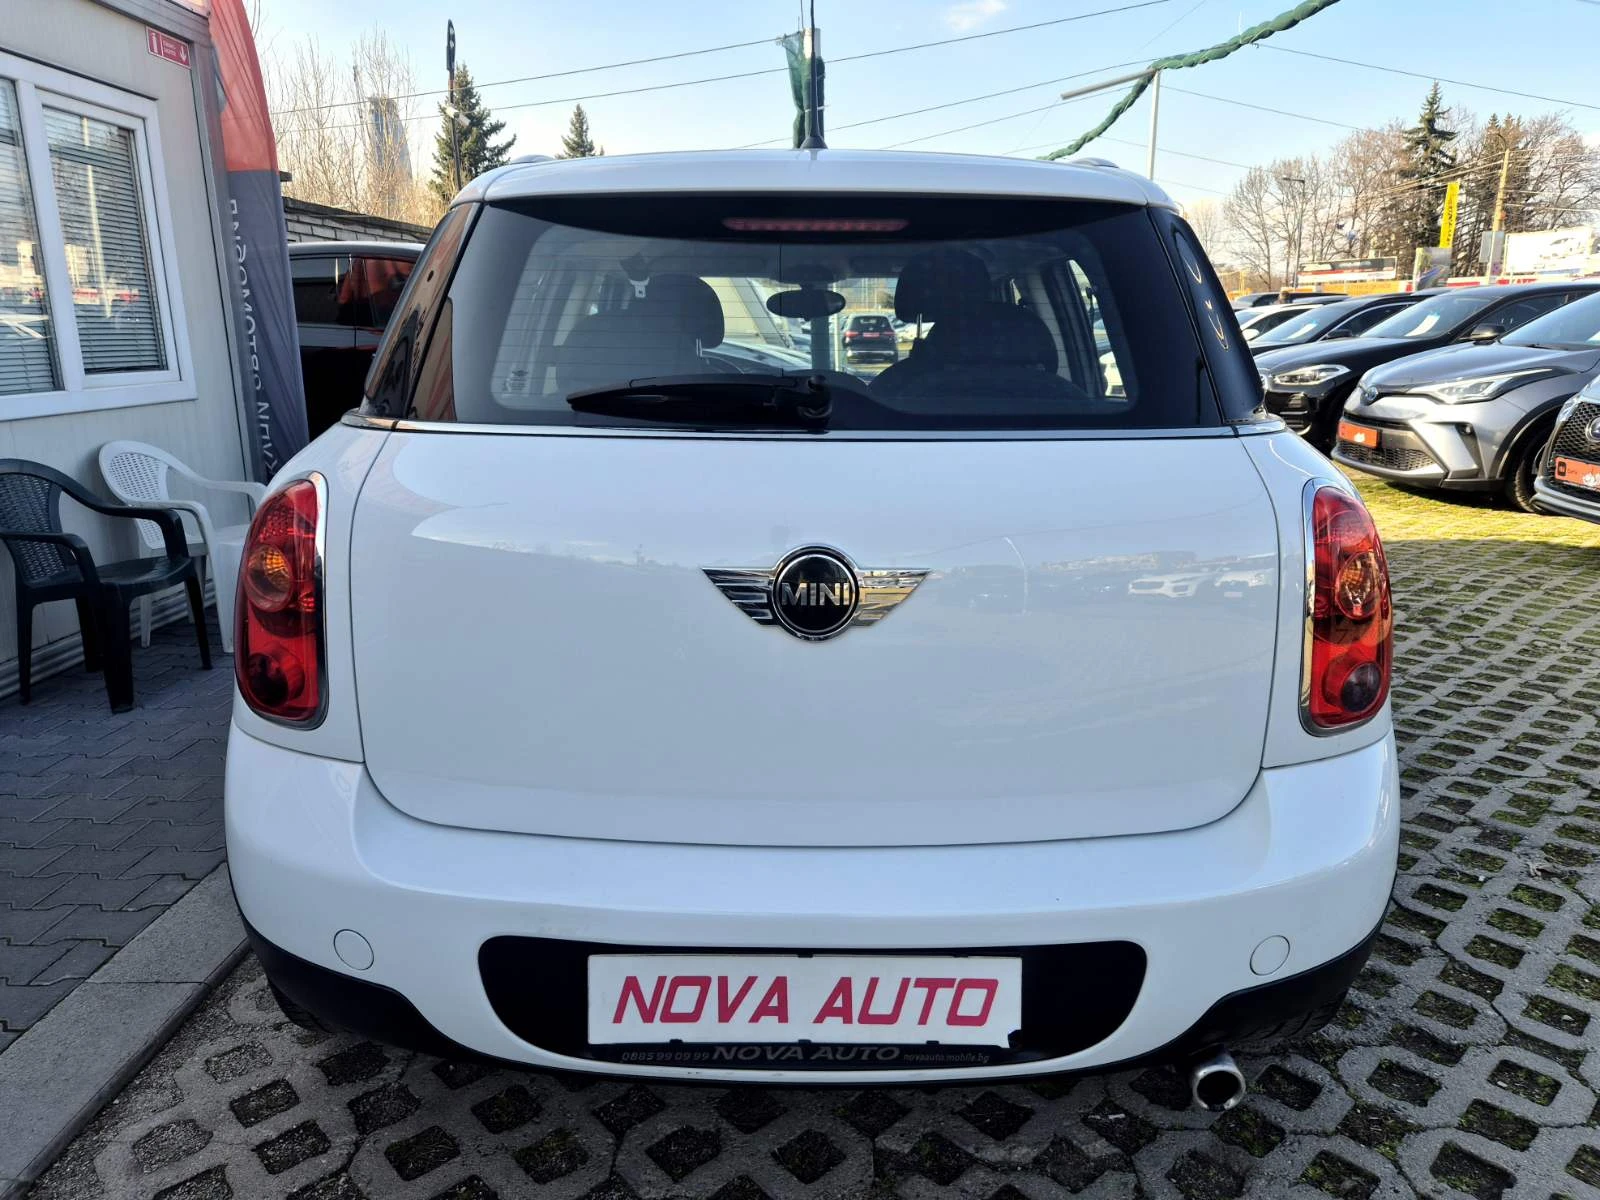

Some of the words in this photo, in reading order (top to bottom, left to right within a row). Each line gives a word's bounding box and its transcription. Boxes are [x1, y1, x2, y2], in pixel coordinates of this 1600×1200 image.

[780, 582, 850, 607] MINI
[612, 975, 789, 1024] NOVA
[812, 976, 999, 1027] AUTO
[711, 1045, 804, 1061] NOVA
[810, 1046, 901, 1061] AUTO
